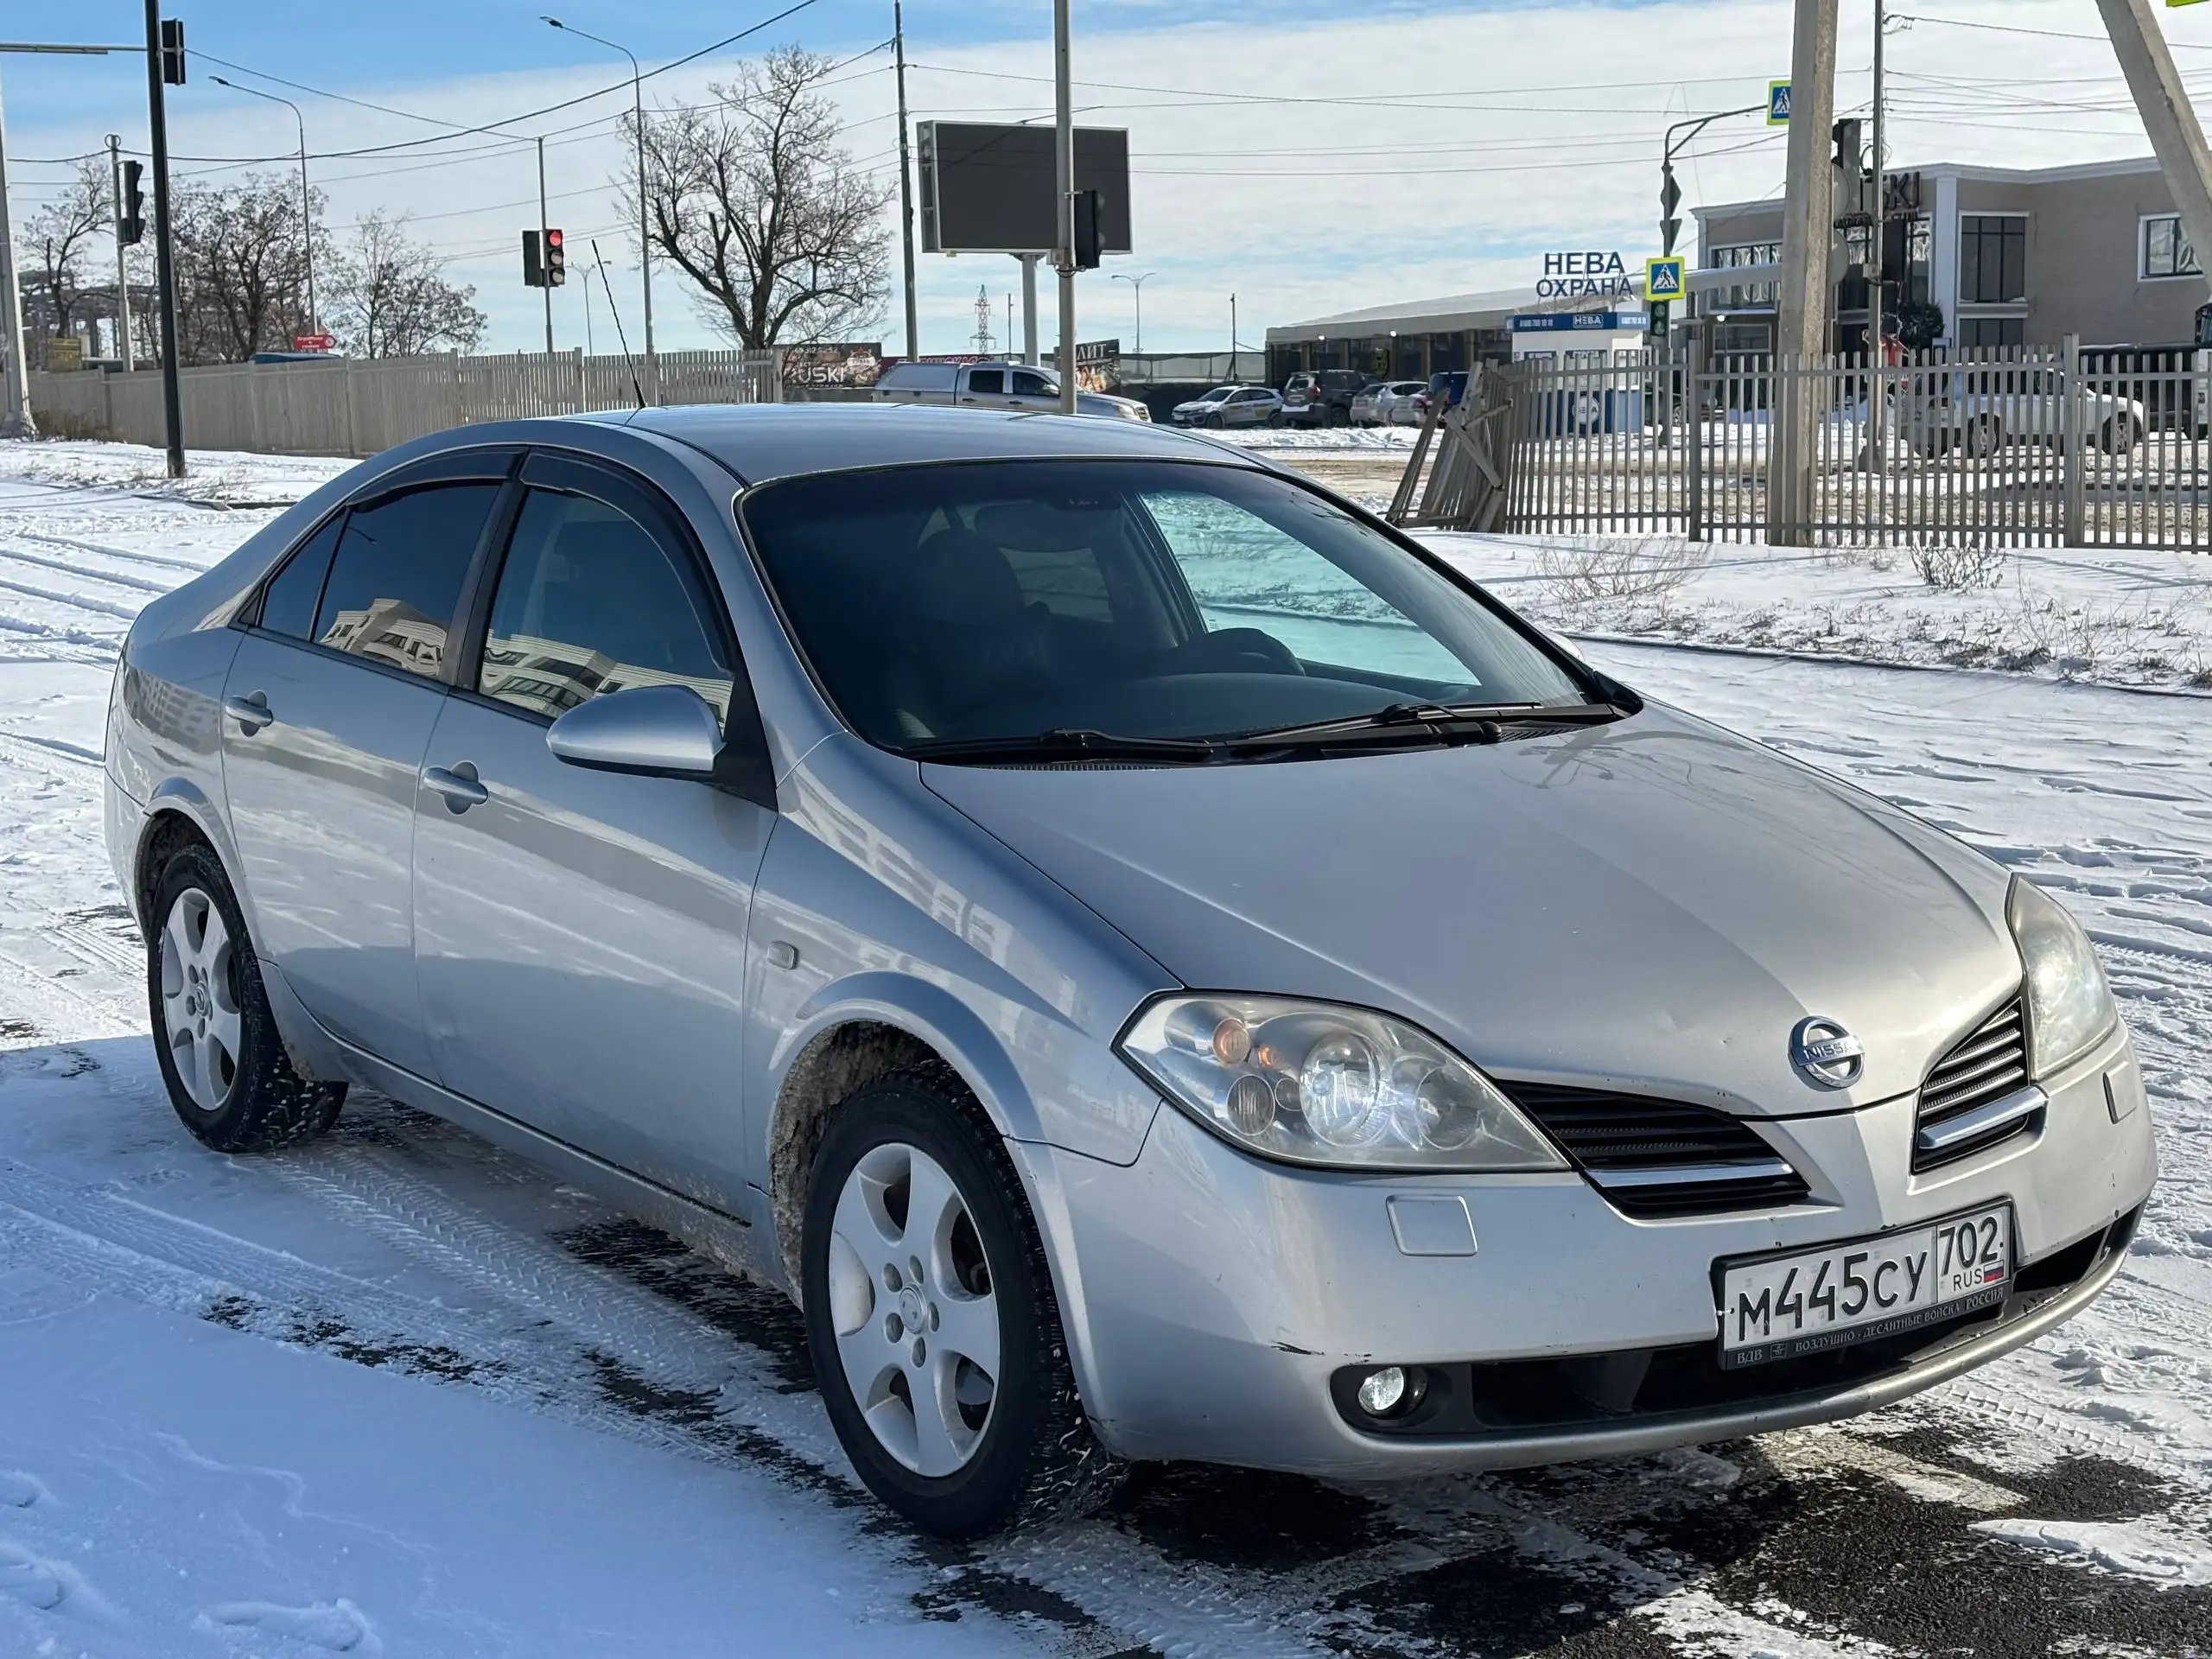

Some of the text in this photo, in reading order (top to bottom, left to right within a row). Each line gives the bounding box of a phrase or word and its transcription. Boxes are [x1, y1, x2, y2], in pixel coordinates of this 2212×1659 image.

[1544, 251, 1625, 275] НЕВА
[1536, 277, 1633, 297] ОХРАНА
[1077, 344, 1107, 361] ЛИТ
[1803, 1039, 1858, 1060] NISS
[1738, 1216, 1999, 1342] М445СУ 702
[1953, 1272, 1983, 1292] RUS
[1737, 1348, 1763, 1364] ВДВ
[1795, 1331, 1855, 1352] ВОЗДУШНО
[1862, 1314, 1923, 1338] ДЕСАНТНЫЕ
[1966, 1287, 2004, 1311] РОССИЯ
